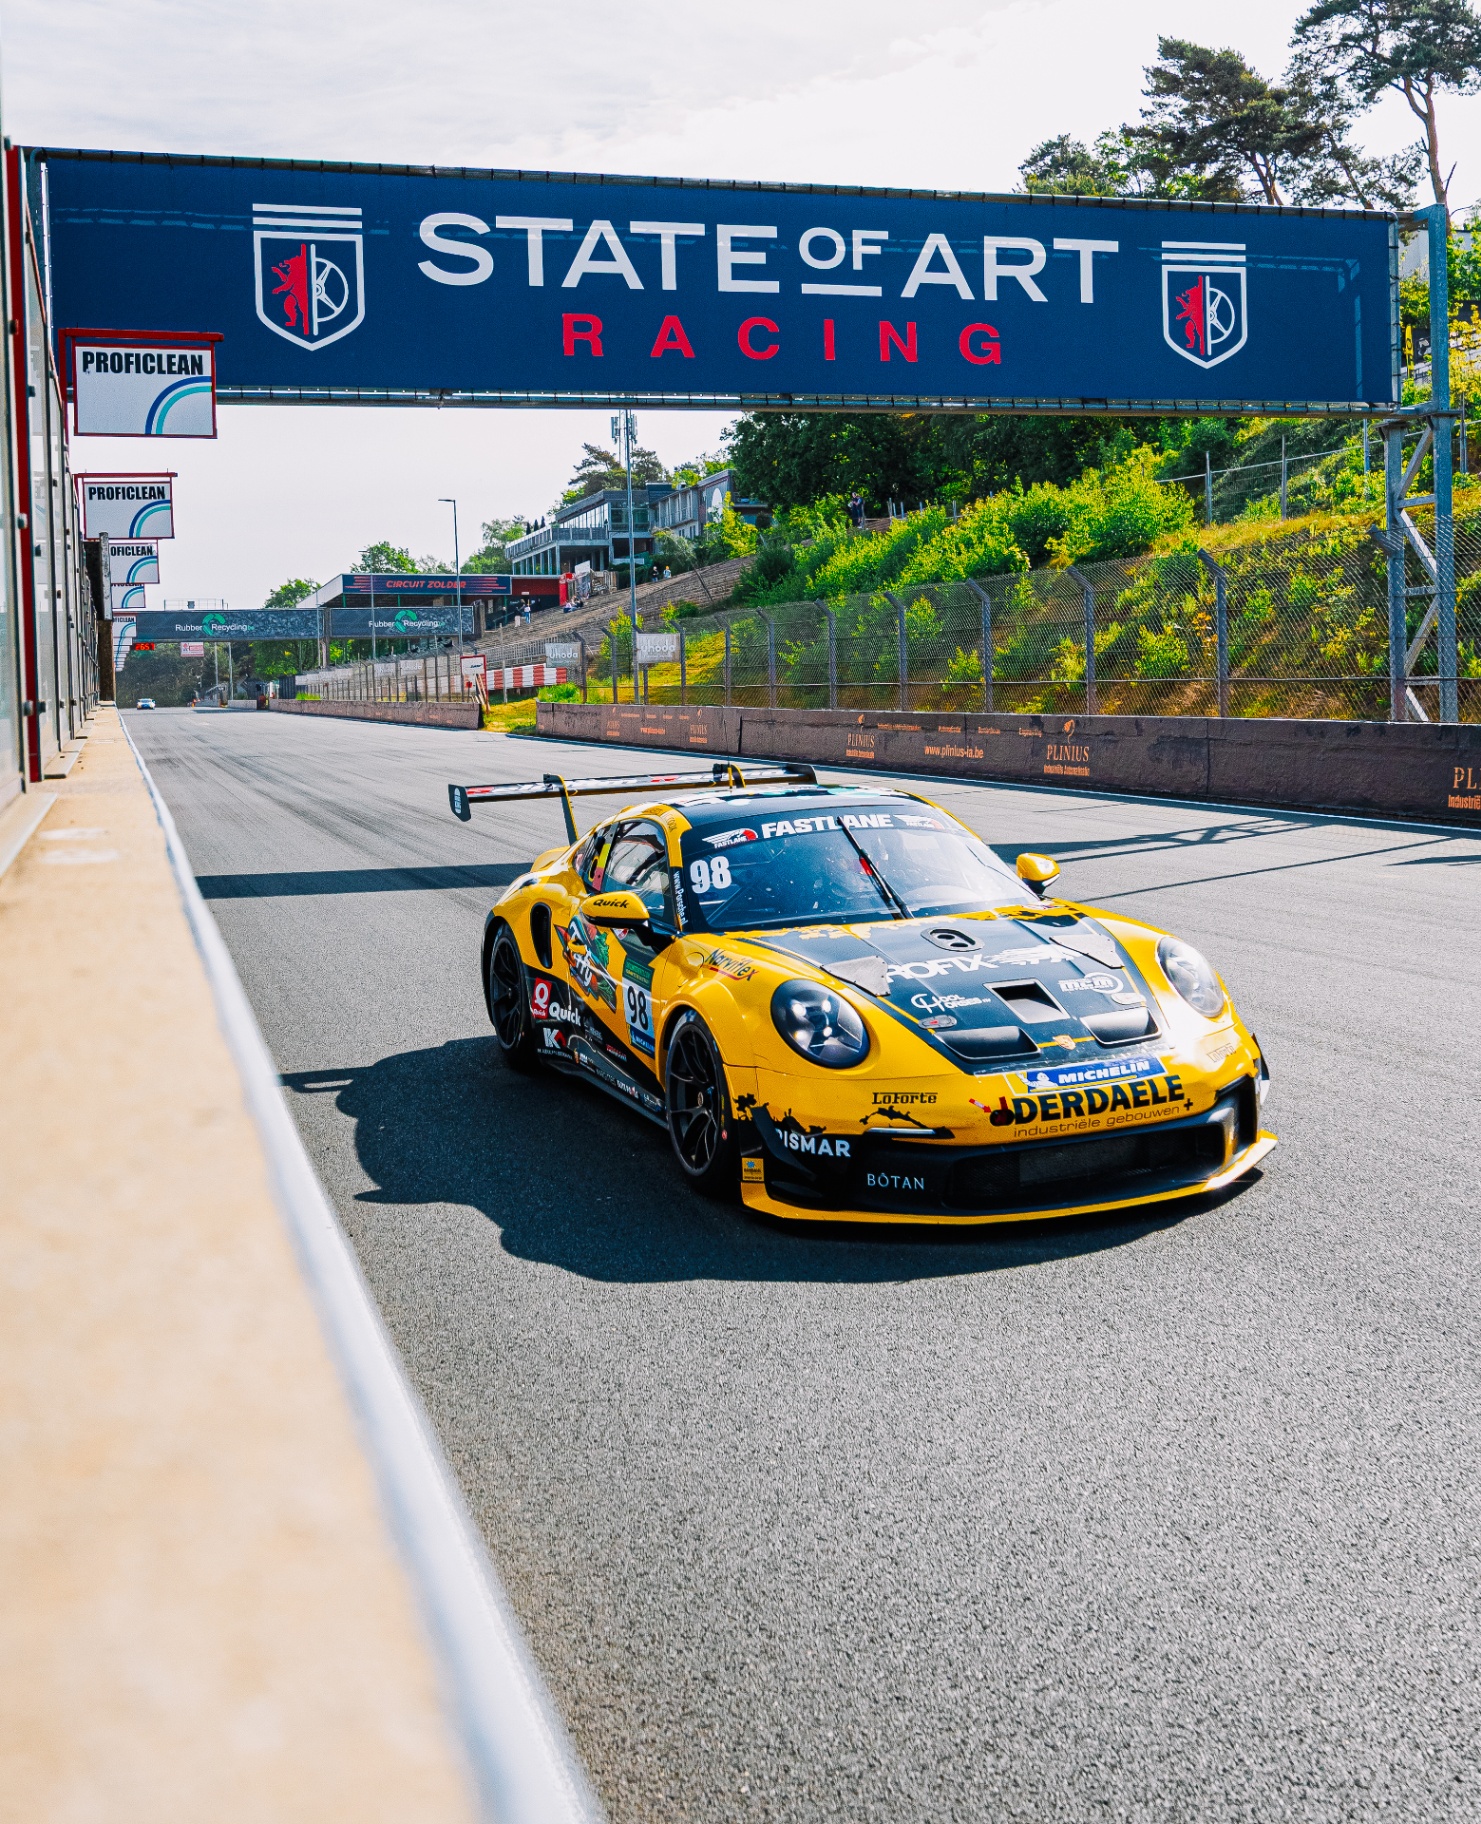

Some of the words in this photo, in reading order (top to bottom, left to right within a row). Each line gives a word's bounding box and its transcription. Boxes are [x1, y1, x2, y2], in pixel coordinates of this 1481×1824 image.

[417, 212, 780, 294] STATE
[798, 227, 889, 270] OF
[900, 233, 1119, 304] ART
[562, 313, 1002, 365] RACING
[82, 351, 204, 375] PROFICLEAN
[88, 486, 166, 501] PROFICLEAN
[110, 546, 154, 557] OFICLEAN
[386, 580, 426, 589] CIRCUIT
[427, 580, 467, 589] ZOLDER
[175, 624, 203, 632] Rubber
[1046, 744, 1090, 762] PLINIUS
[1453, 766, 1481, 789] PL
[761, 814, 894, 839] FASTLANE
[690, 856, 732, 894] 98
[593, 898, 629, 909] Quick
[887, 954, 999, 983] ROFIX
[549, 1002, 582, 1026] Quick
[627, 985, 649, 1031] 98
[1058, 1060, 1150, 1084] MICHELIN
[1011, 1074, 1185, 1126] DERDAELE
[1014, 1119, 1101, 1138] industriële
[1106, 1105, 1179, 1128] gebouwen
[867, 1172, 925, 1190] BÔTAN
